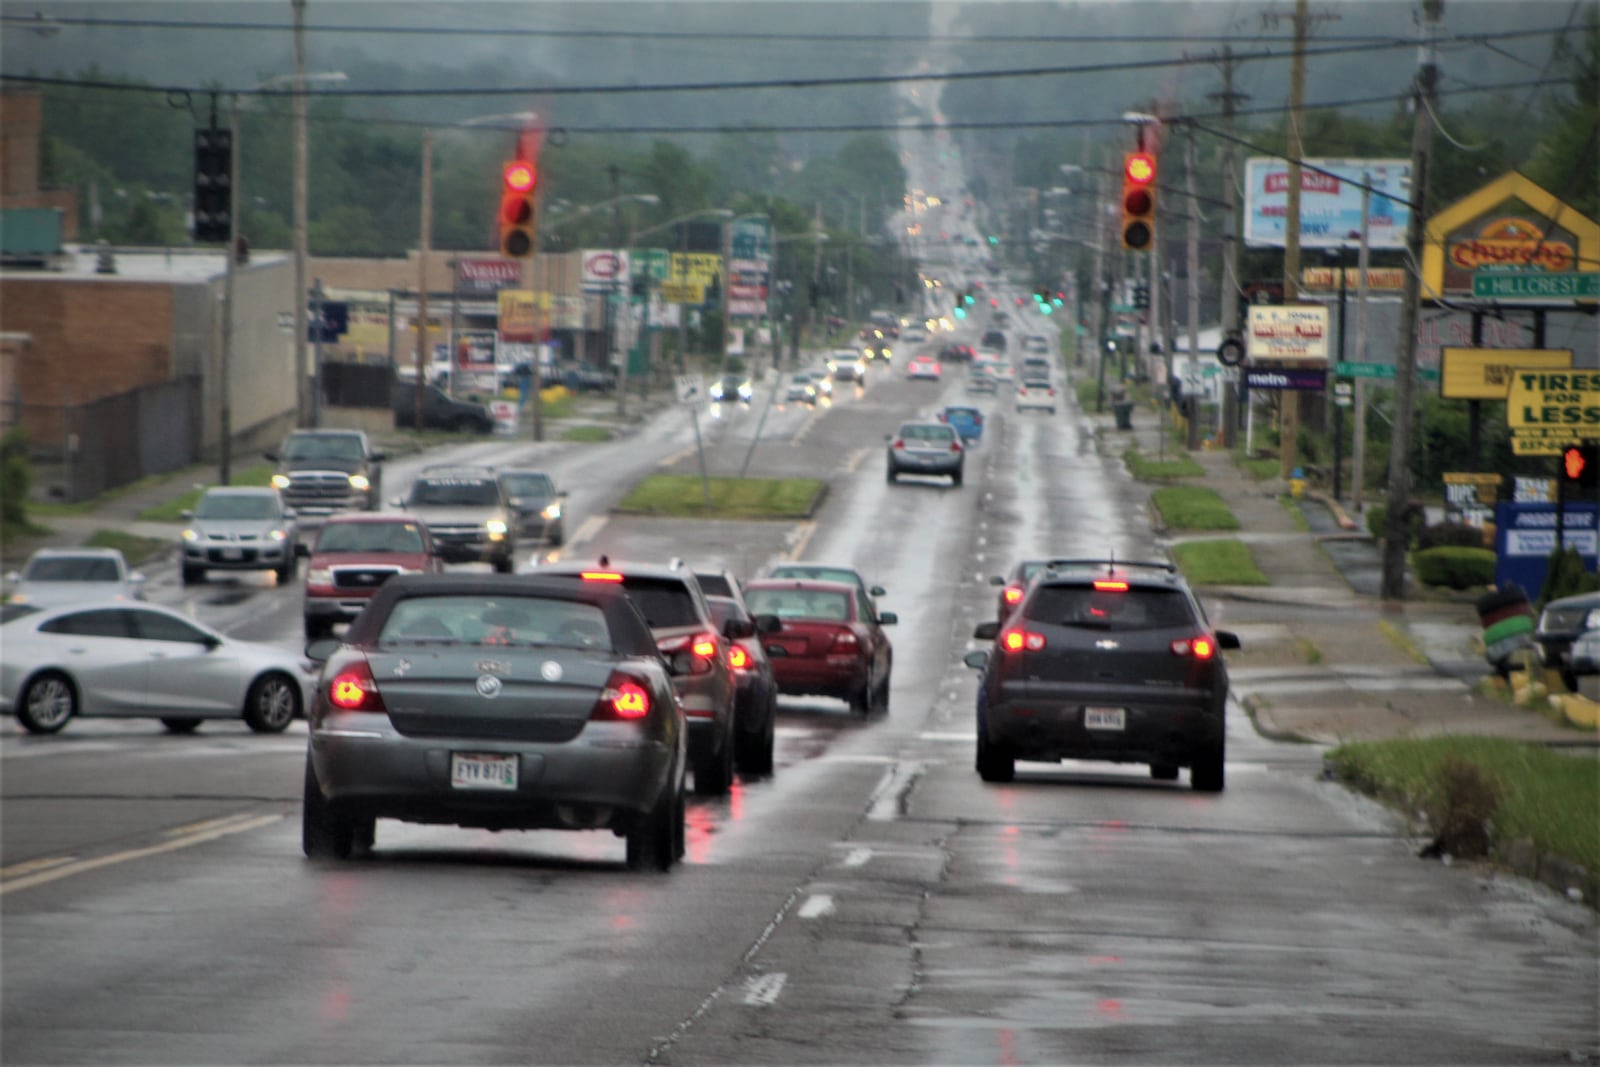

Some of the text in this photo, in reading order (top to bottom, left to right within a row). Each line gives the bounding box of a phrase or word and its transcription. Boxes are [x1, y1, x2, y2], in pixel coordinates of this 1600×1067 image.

[1493, 278, 1577, 293] HILLCREST
[1248, 373, 1288, 385] metro
[1520, 374, 1600, 391] TIRES
[1543, 393, 1582, 403] FOR
[1523, 406, 1600, 423] LESS
